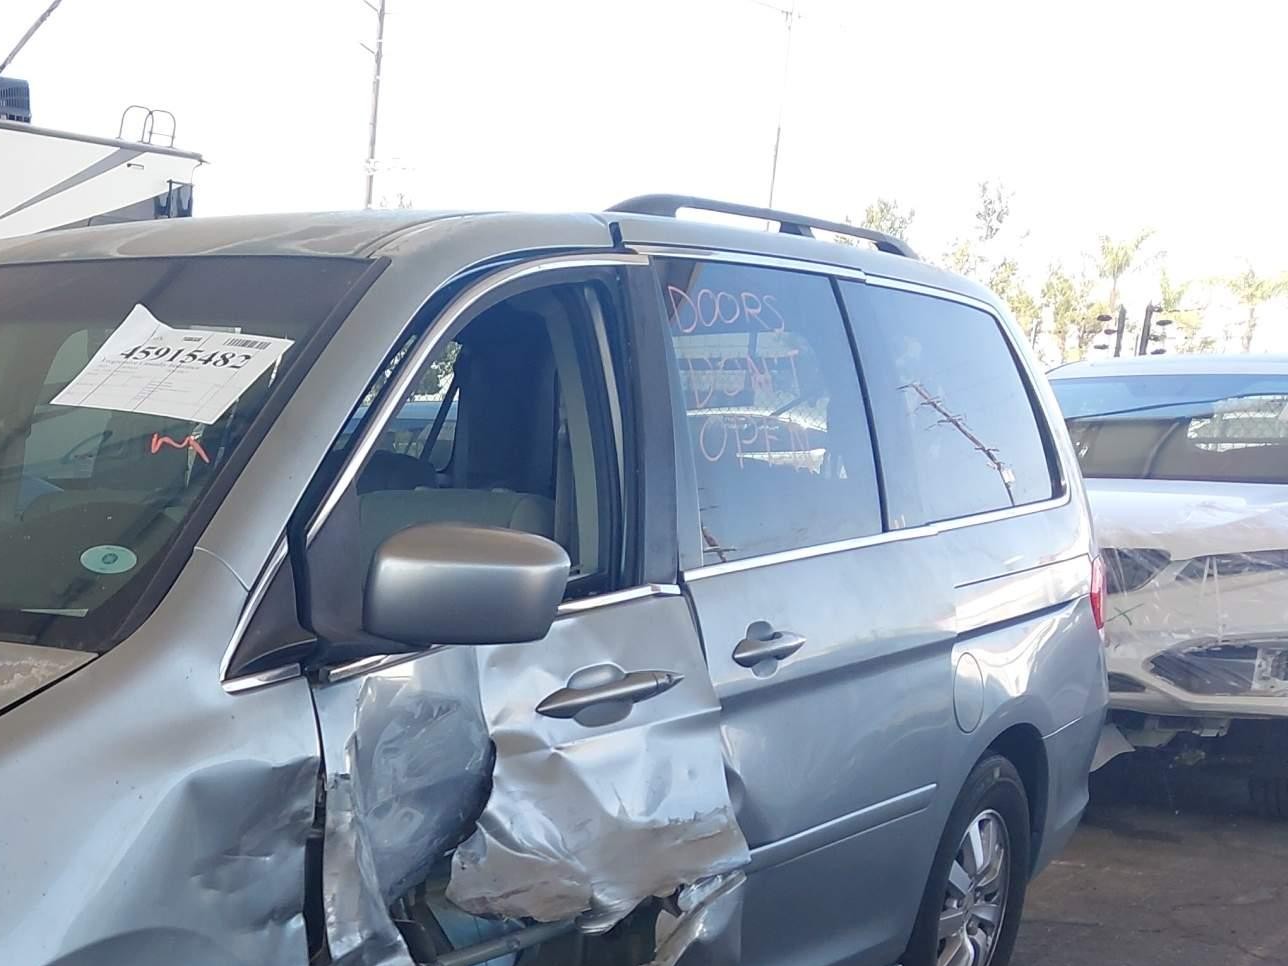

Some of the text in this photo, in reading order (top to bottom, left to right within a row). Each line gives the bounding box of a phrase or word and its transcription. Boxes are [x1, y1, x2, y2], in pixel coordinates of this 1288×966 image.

[667, 285, 785, 334] DOORS
[120, 345, 252, 370] 45915482
[699, 415, 815, 474] OPEN
